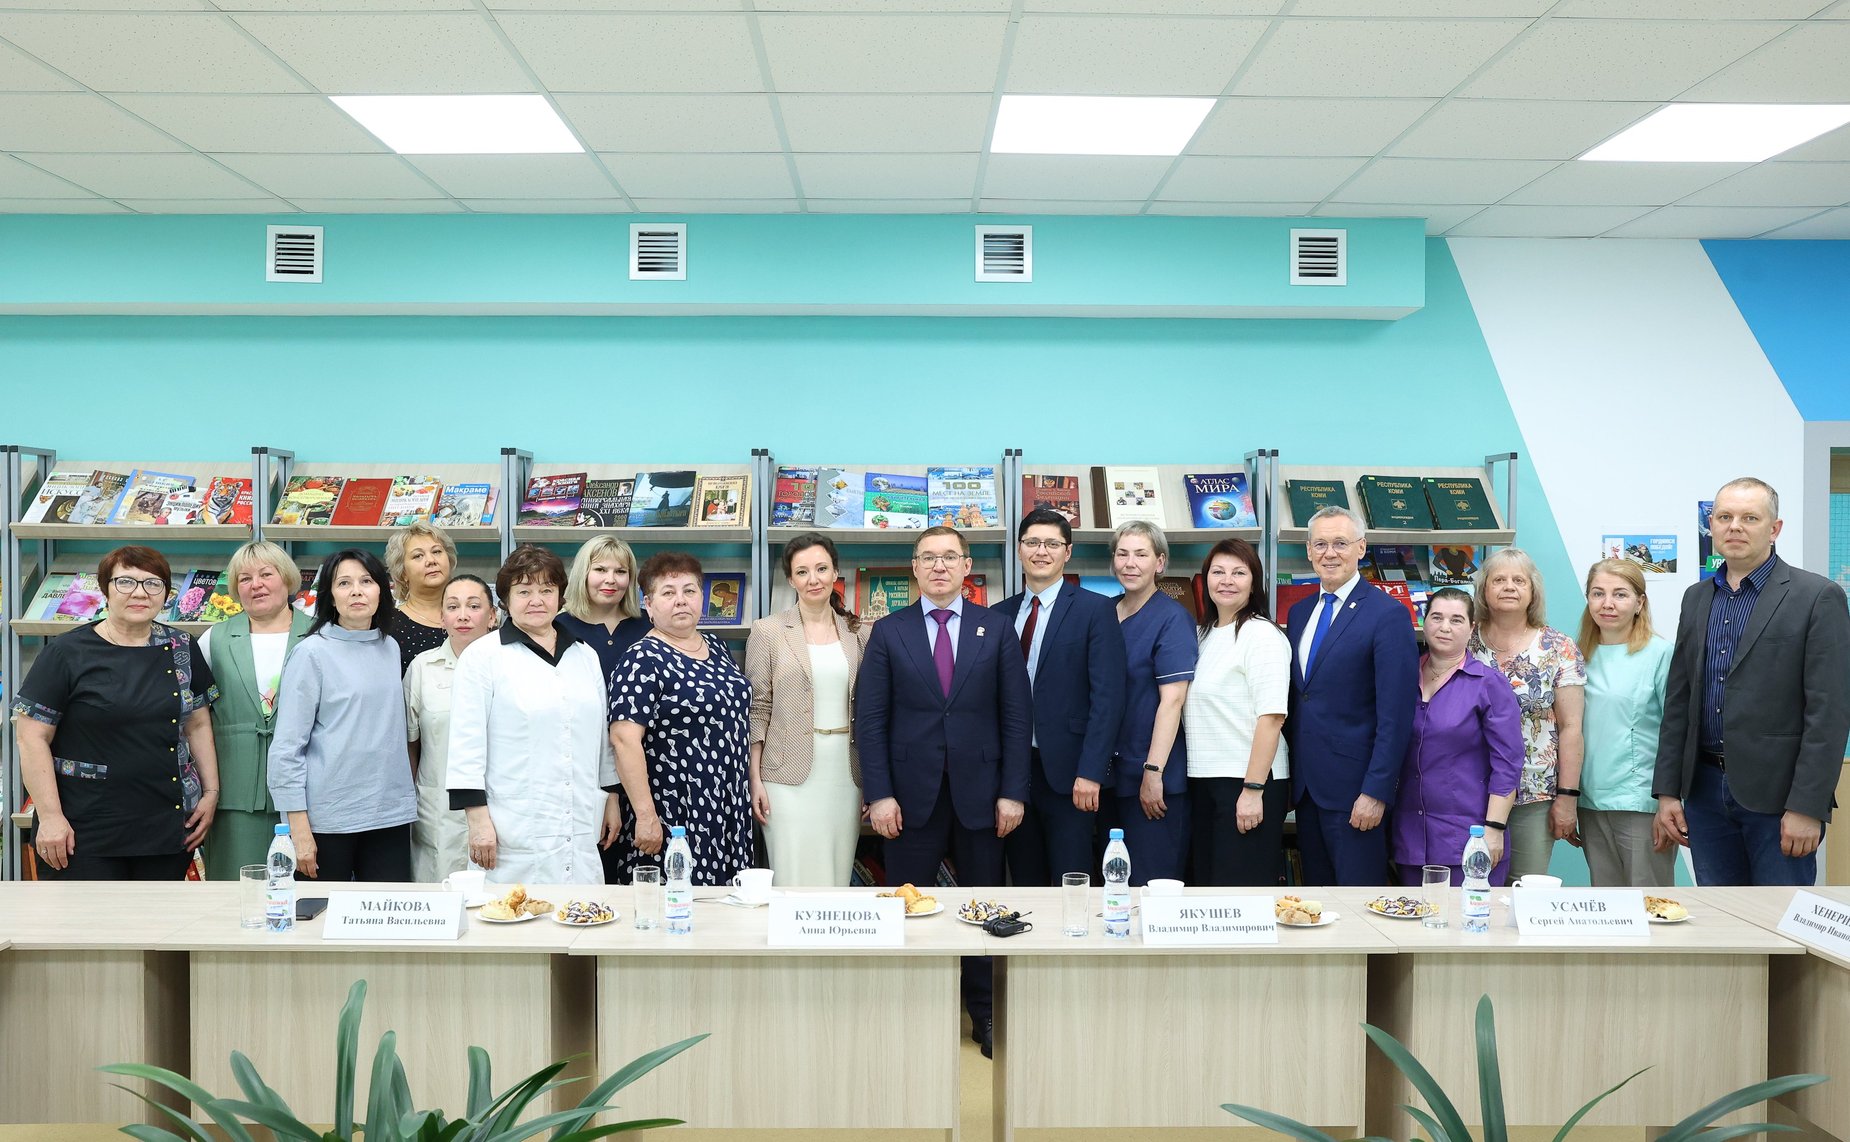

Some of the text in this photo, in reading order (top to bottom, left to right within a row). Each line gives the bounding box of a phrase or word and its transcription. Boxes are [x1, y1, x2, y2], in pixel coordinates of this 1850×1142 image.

[942, 481, 982, 490] 100
[1200, 477, 1230, 485] АТЛАС
[445, 485, 487, 494] Макраме
[1195, 484, 1240, 493] МИРА
[360, 899, 431, 912] МАЙКОВА
[1550, 899, 1607, 912] УСАЧЁВ
[795, 910, 881, 922] КУЗНЕЦОВА
[1180, 908, 1242, 919] ЯКУШЕВ
[342, 916, 446, 925] Татьяна Васильевна
[1529, 916, 1633, 926] Сергей Анатольевич
[799, 926, 877, 937] Анна Юрьевна
[1148, 923, 1275, 934] Владимир Владимирович
[1793, 913, 1850, 942] Владимир Ивано
